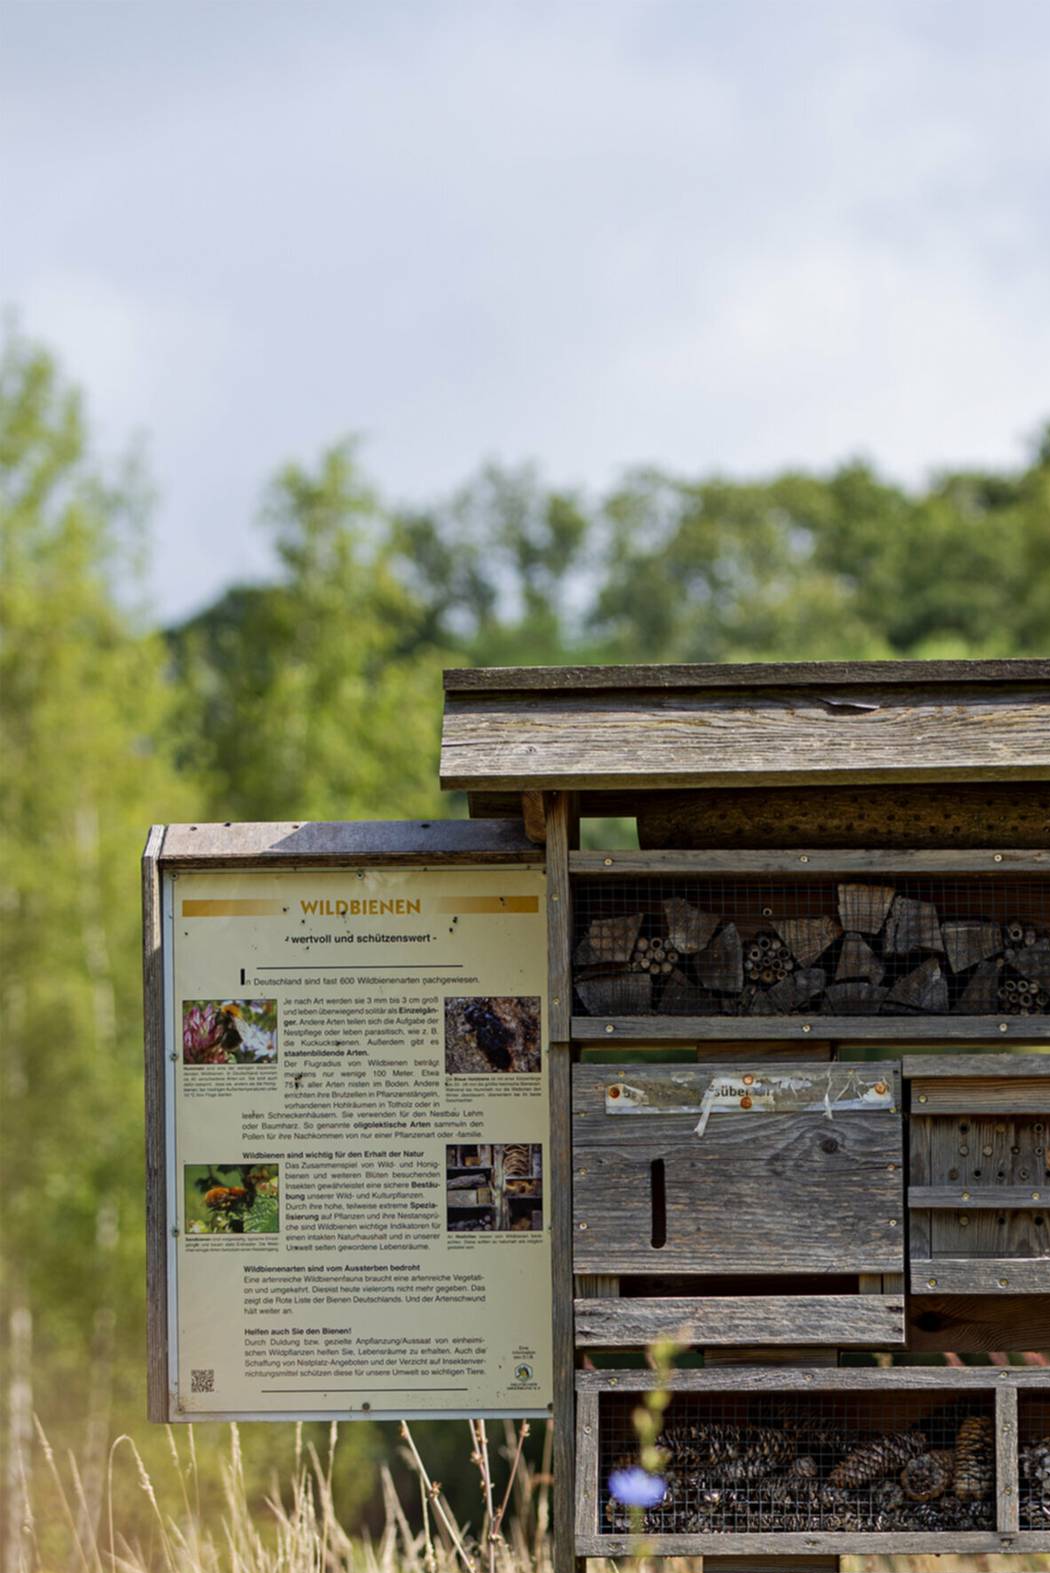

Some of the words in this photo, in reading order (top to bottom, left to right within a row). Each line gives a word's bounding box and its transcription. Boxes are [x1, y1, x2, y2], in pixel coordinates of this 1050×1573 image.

[300, 899, 420, 915] WILDBIENEN
[290, 933, 331, 944] wertvoll
[334, 933, 354, 944] und
[356, 932, 430, 943] schützenswert
[253, 977, 301, 985] Deutschland
[304, 977, 321, 985] sind
[322, 977, 337, 985] fast
[339, 976, 355, 985] 600
[356, 976, 420, 985] Wildbienenarten
[398, 1006, 439, 1016] Einzelgän-
[283, 1019, 298, 1028] ger.
[283, 1048, 344, 1056] staatenbildende
[346, 1048, 370, 1056] Arten.
[352, 1120, 407, 1130] oligolektische
[409, 1120, 431, 1128] Arten
[242, 1150, 285, 1158] Wildbienen
[286, 1150, 304, 1158] sind
[305, 1150, 333, 1160] wichtig
[334, 1150, 346, 1158] für
[347, 1149, 362, 1158] den
[363, 1149, 387, 1158] Erhalt
[388, 1149, 401, 1158] der
[403, 1149, 424, 1158] Natur
[410, 1180, 440, 1189] Bestäu-
[285, 1191, 305, 1202] bung
[409, 1201, 438, 1211] Spezia-
[285, 1212, 319, 1222] lisierung
[243, 1264, 306, 1272] Wildbienenarten
[307, 1264, 324, 1272] sind
[344, 1263, 388, 1272] Aussterben
[389, 1263, 420, 1272] bedroht
[244, 1327, 269, 1335] Helfen
[270, 1326, 290, 1335] auch
[291, 1326, 304, 1335] Sie
[305, 1326, 320, 1335] den
[321, 1326, 351, 1334] Bienen!
